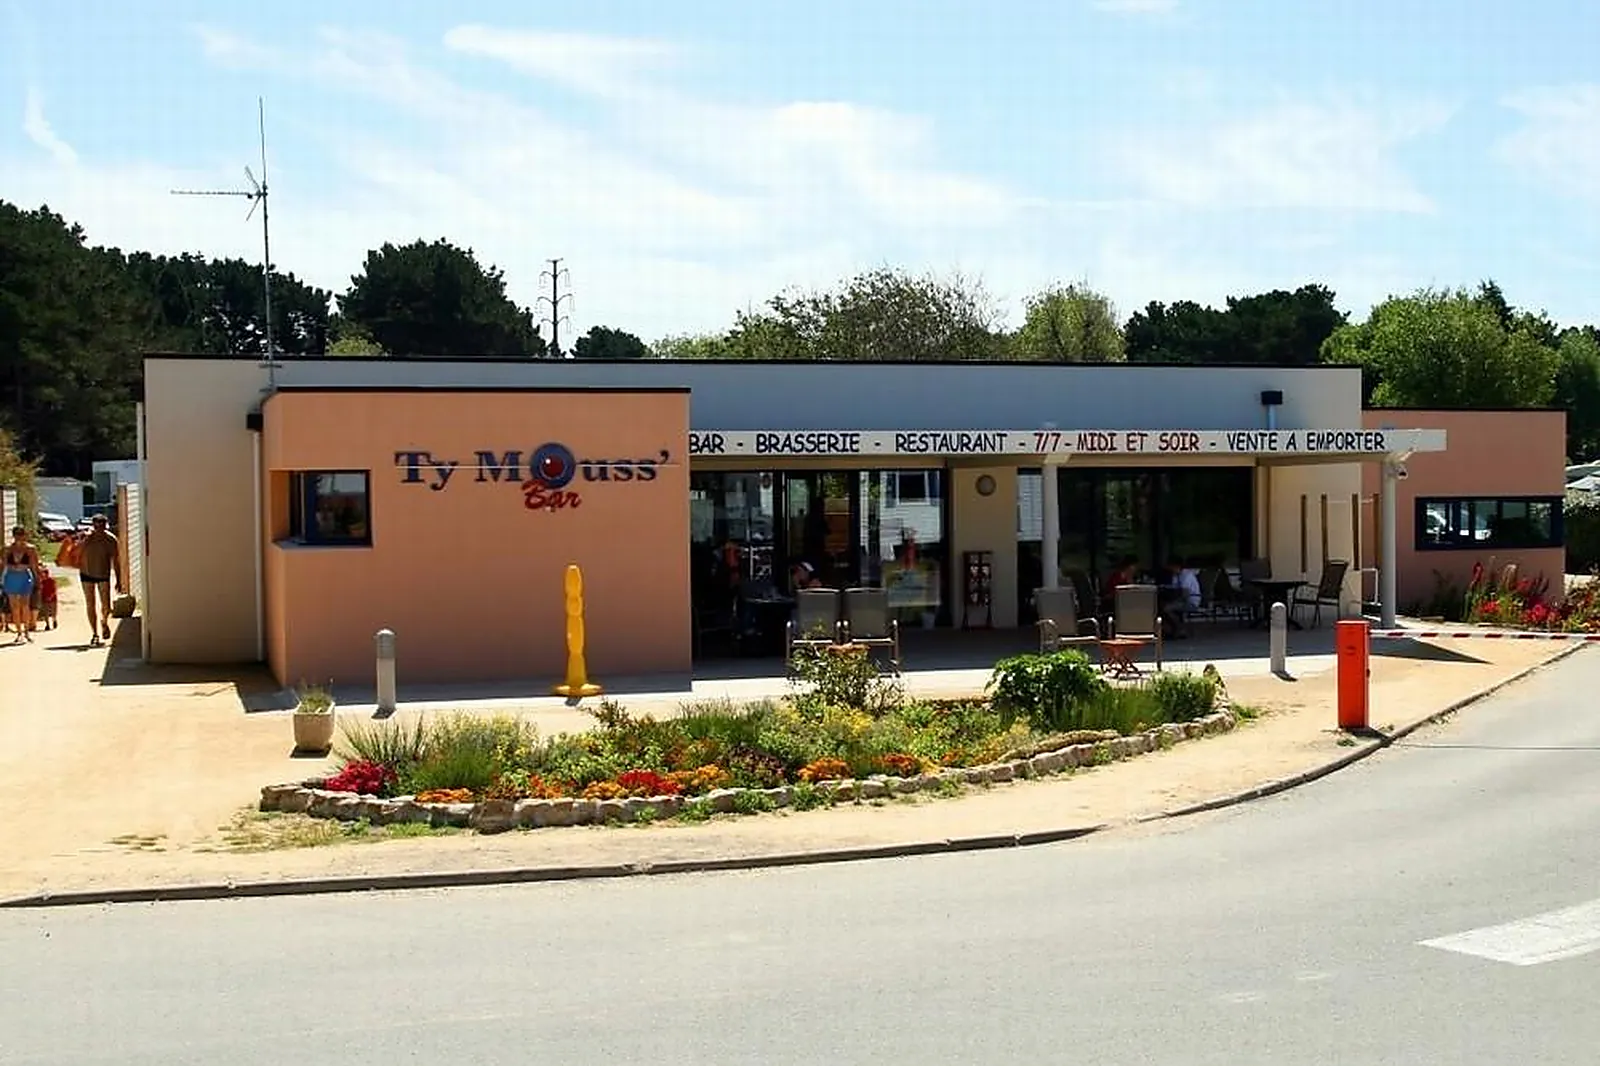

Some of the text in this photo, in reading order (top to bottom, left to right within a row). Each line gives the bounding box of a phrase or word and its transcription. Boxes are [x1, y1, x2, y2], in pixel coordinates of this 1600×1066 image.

[689, 432, 725, 453] BAR
[756, 433, 860, 453] BRASSERIE
[895, 433, 1008, 453] RESTAURANT
[1034, 432, 1061, 452] 7/7
[1077, 433, 1118, 452] MIDI
[1126, 433, 1149, 452] ET
[1158, 432, 1200, 452] SOIR
[1227, 432, 1278, 451] VENTE
[1286, 432, 1298, 450] A
[1306, 432, 1385, 451] EMPORTER
[394, 450, 458, 491] Ty
[522, 479, 581, 511] Bar
